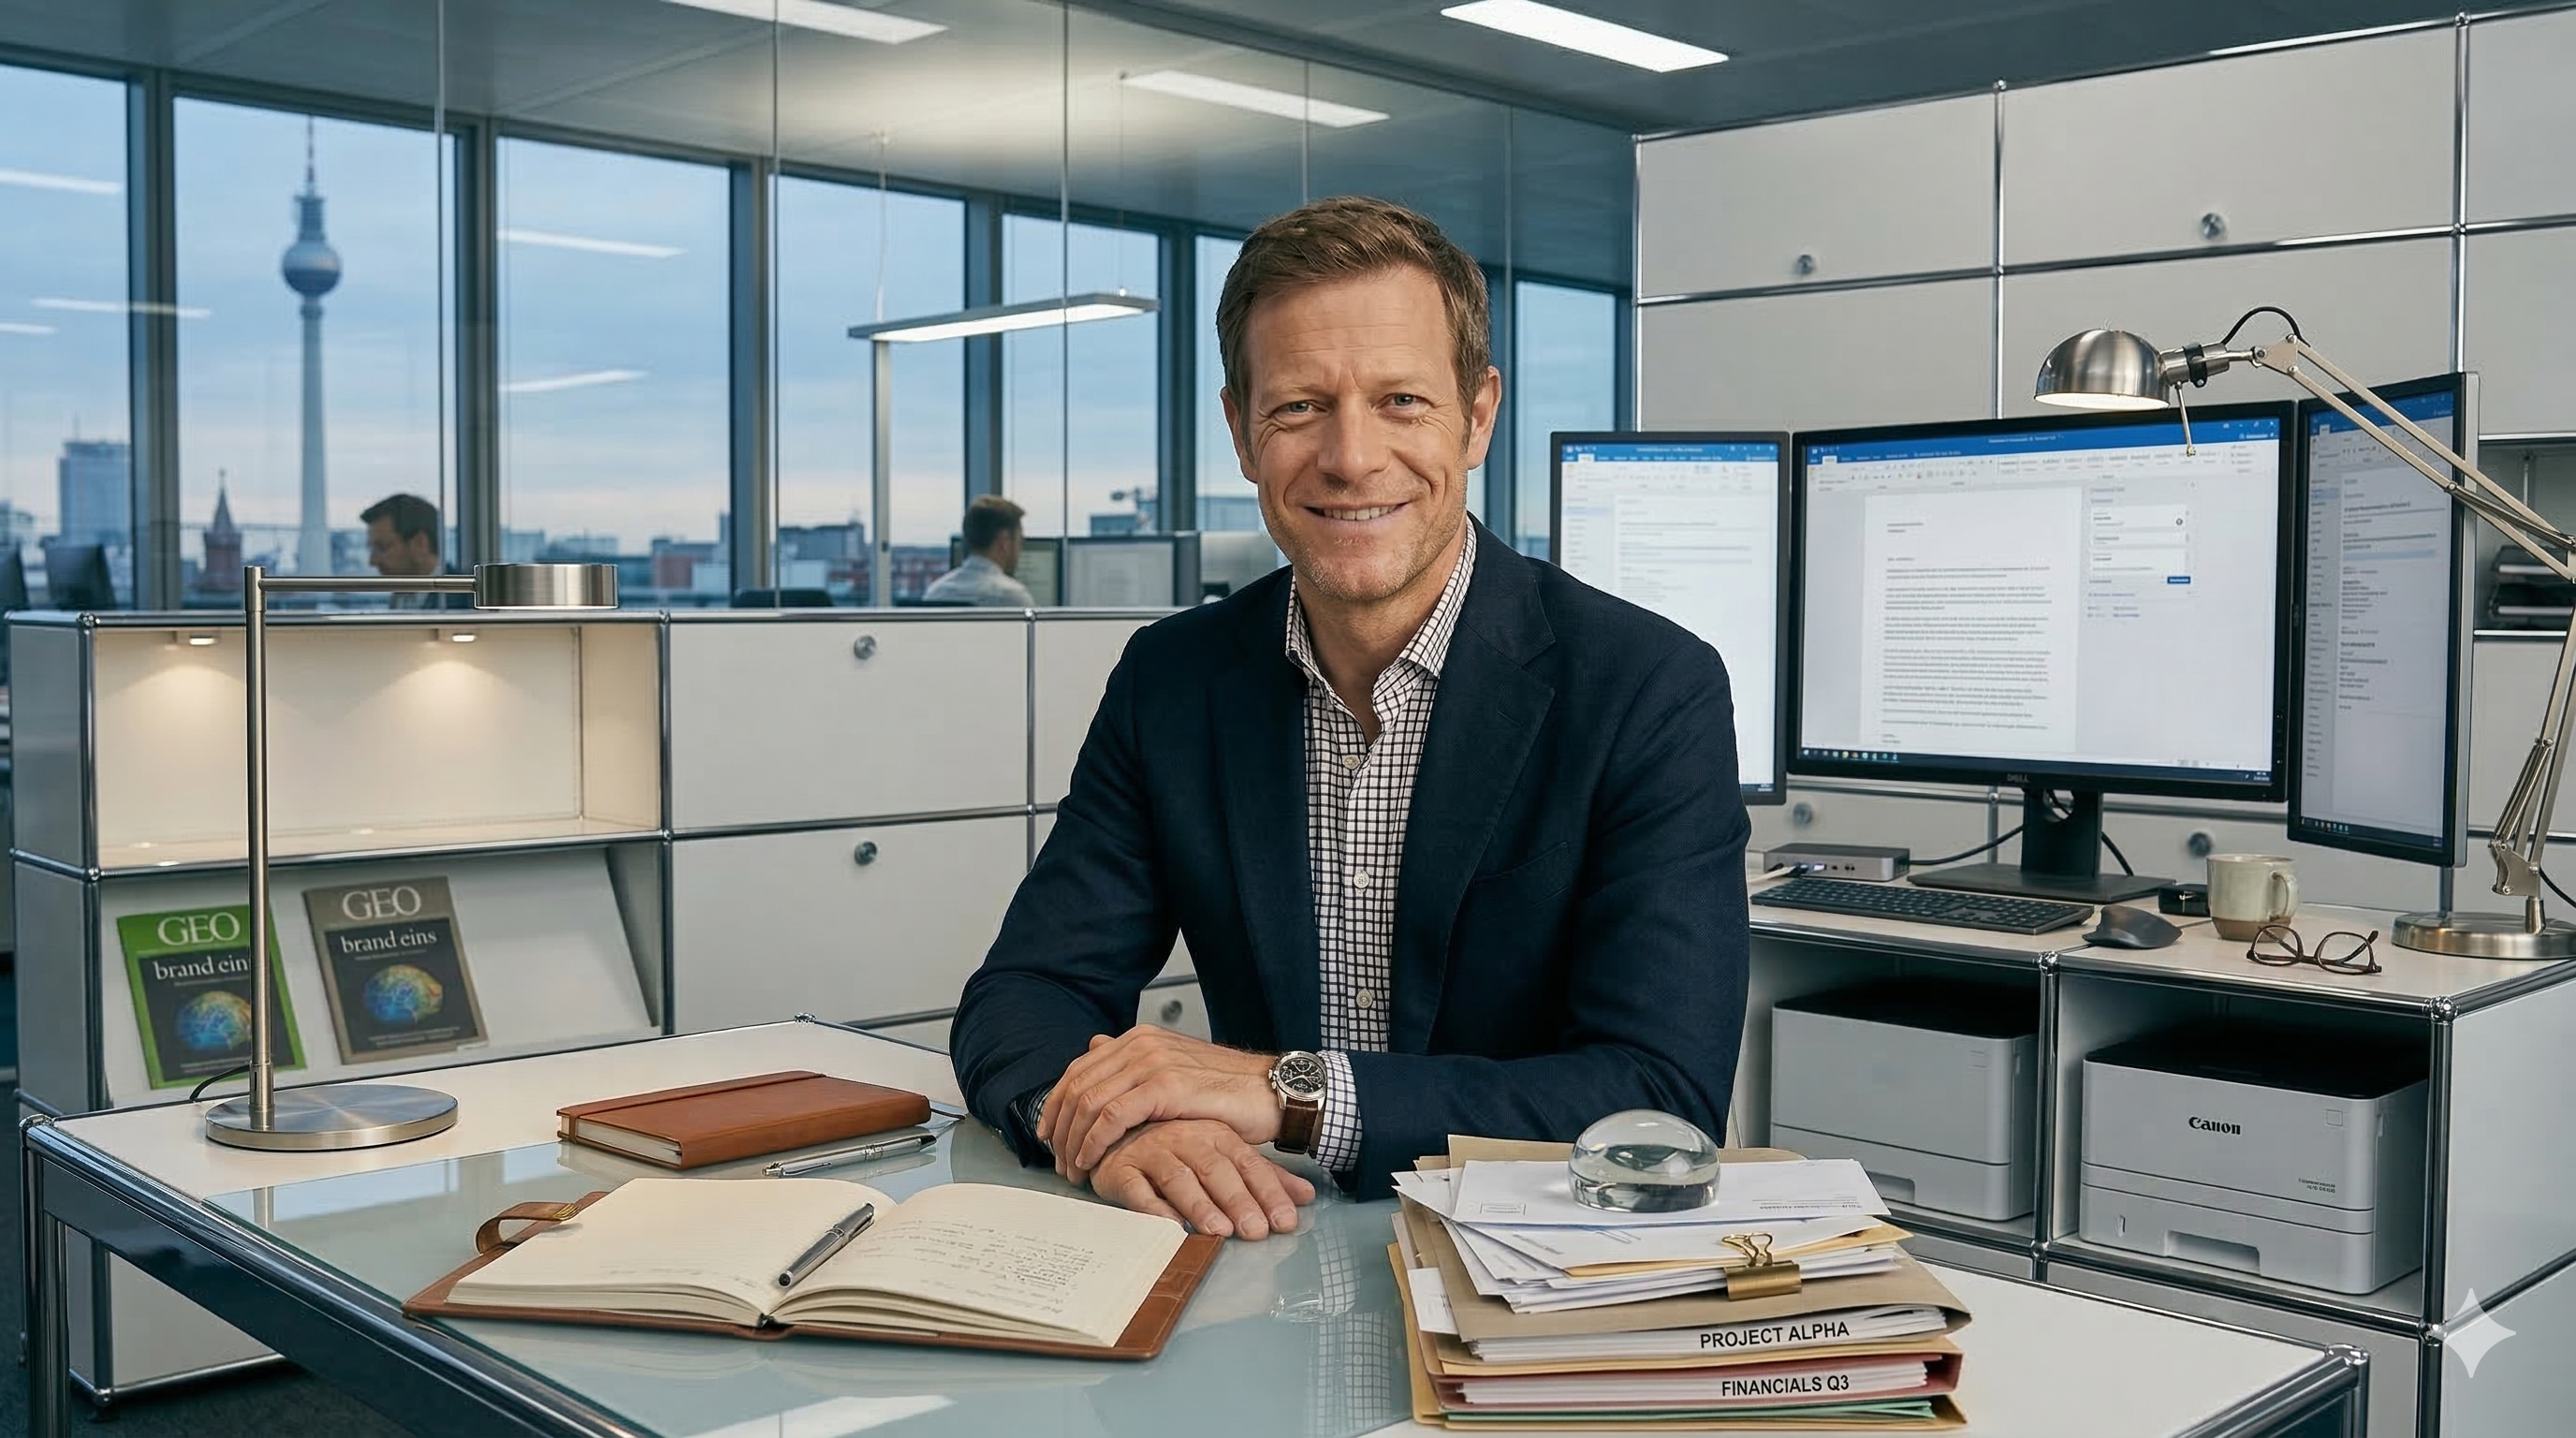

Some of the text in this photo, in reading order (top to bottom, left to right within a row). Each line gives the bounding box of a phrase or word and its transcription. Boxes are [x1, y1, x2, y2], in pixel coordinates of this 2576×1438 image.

[342, 886, 421, 920] GEO
[157, 912, 241, 946] GEO
[340, 928, 437, 953] brand eins
[153, 955, 249, 980] brand ein
[2188, 1116, 2241, 1136] Canon
[1700, 1321, 1850, 1349] PROJECT ALPHA
[1721, 1374, 1850, 1396] FINANCIALS Q3
